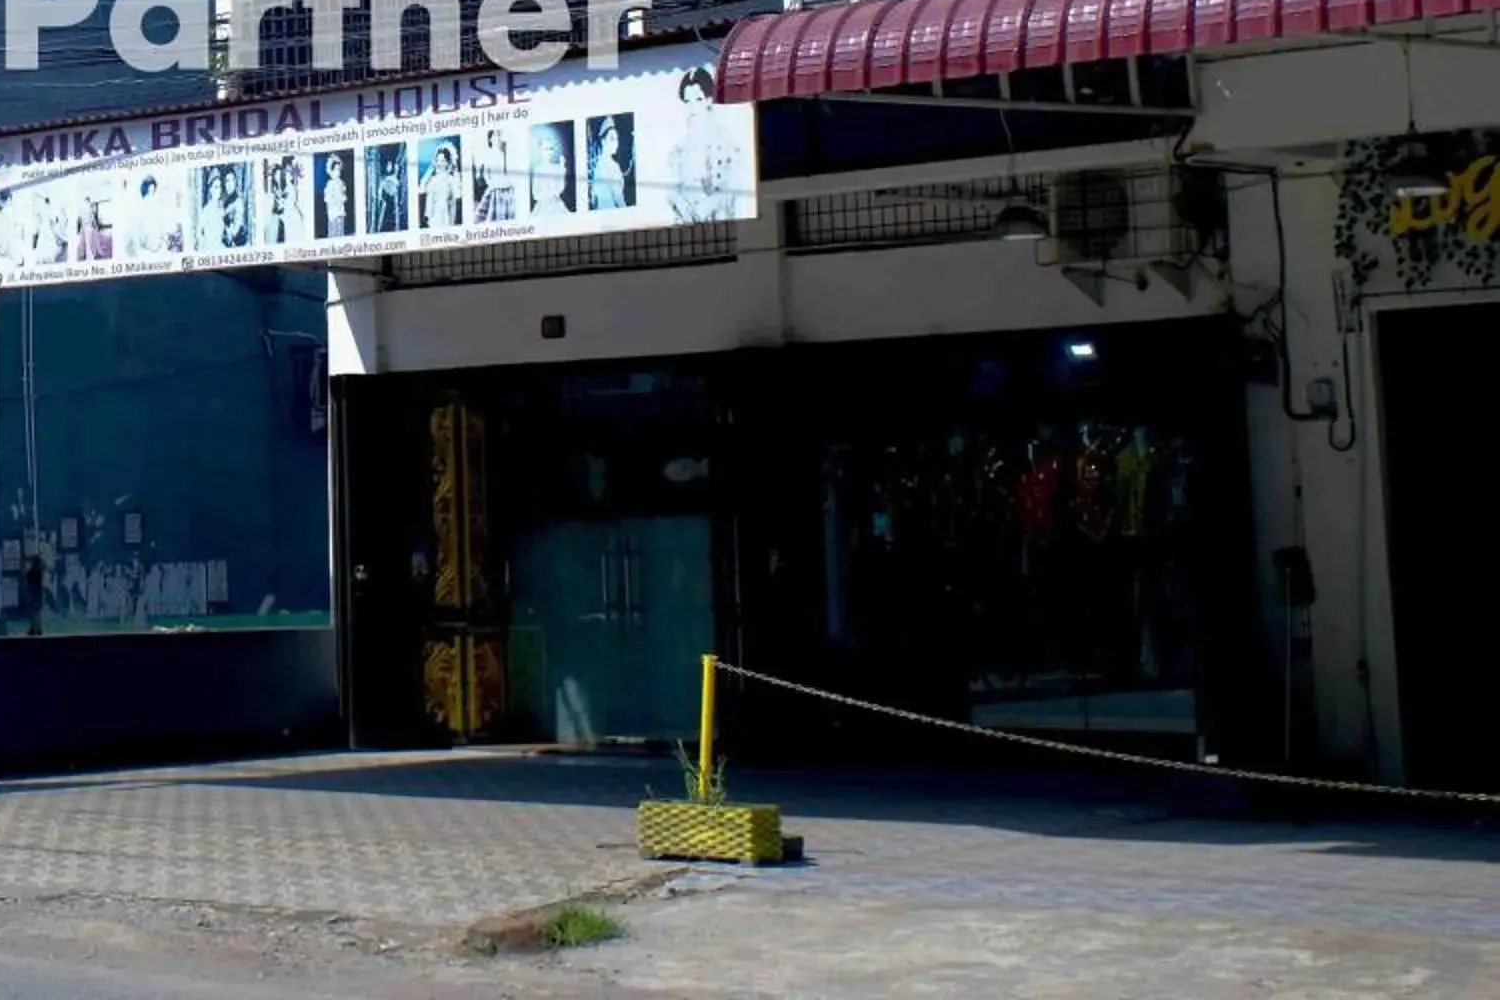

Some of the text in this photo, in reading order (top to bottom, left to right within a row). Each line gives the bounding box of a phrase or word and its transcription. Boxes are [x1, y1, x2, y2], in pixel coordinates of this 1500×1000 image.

[21, 126, 133, 166] MIKA
[151, 99, 335, 151] BRIDAL
[357, 71, 533, 124] HOUSE
[366, 119, 428, 140] smoothing
[434, 112, 479, 133] gunting
[487, 108, 510, 123] hair
[512, 107, 529, 120] do
